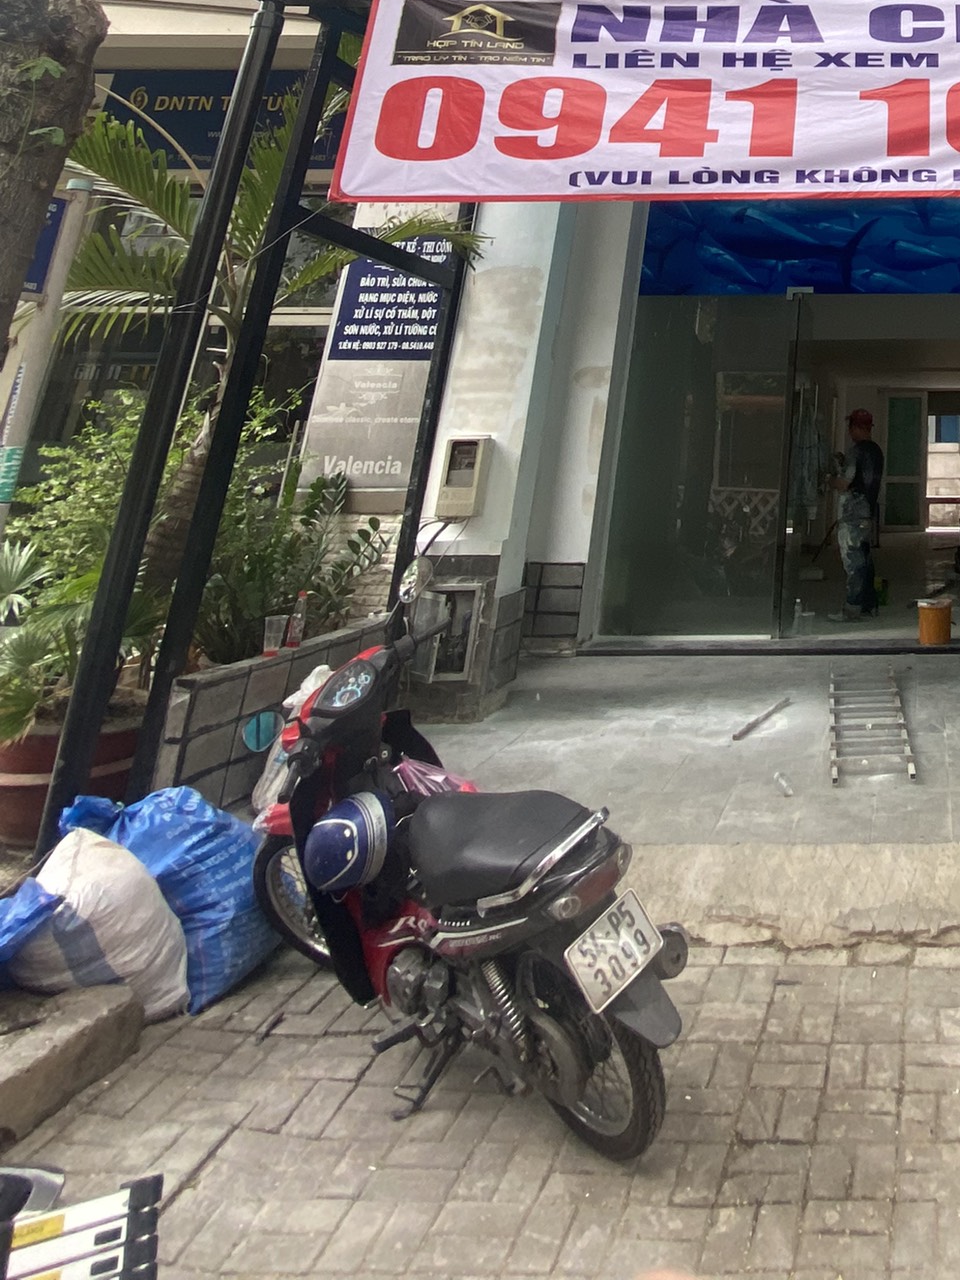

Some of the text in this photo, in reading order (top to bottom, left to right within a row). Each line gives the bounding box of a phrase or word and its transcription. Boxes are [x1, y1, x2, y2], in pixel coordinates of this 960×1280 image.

[487, 41, 525, 50] LAND
[572, 49, 699, 69] LIÊN
[721, 49, 794, 72] HỆ
[814, 51, 940, 69] XEM
[154, 95, 213, 112] DNTN
[374, 75, 799, 162] 0941
[569, 169, 652, 188] (VUI
[668, 166, 780, 185] LÒNG
[796, 167, 937, 185] KHÔNG
[422, 241, 436, 253] THI
[436, 238, 453, 253] CÔN
[358, 293, 379, 304] HẠNG
[354, 381, 398, 389] Valencia
[323, 455, 402, 475] Valencia
